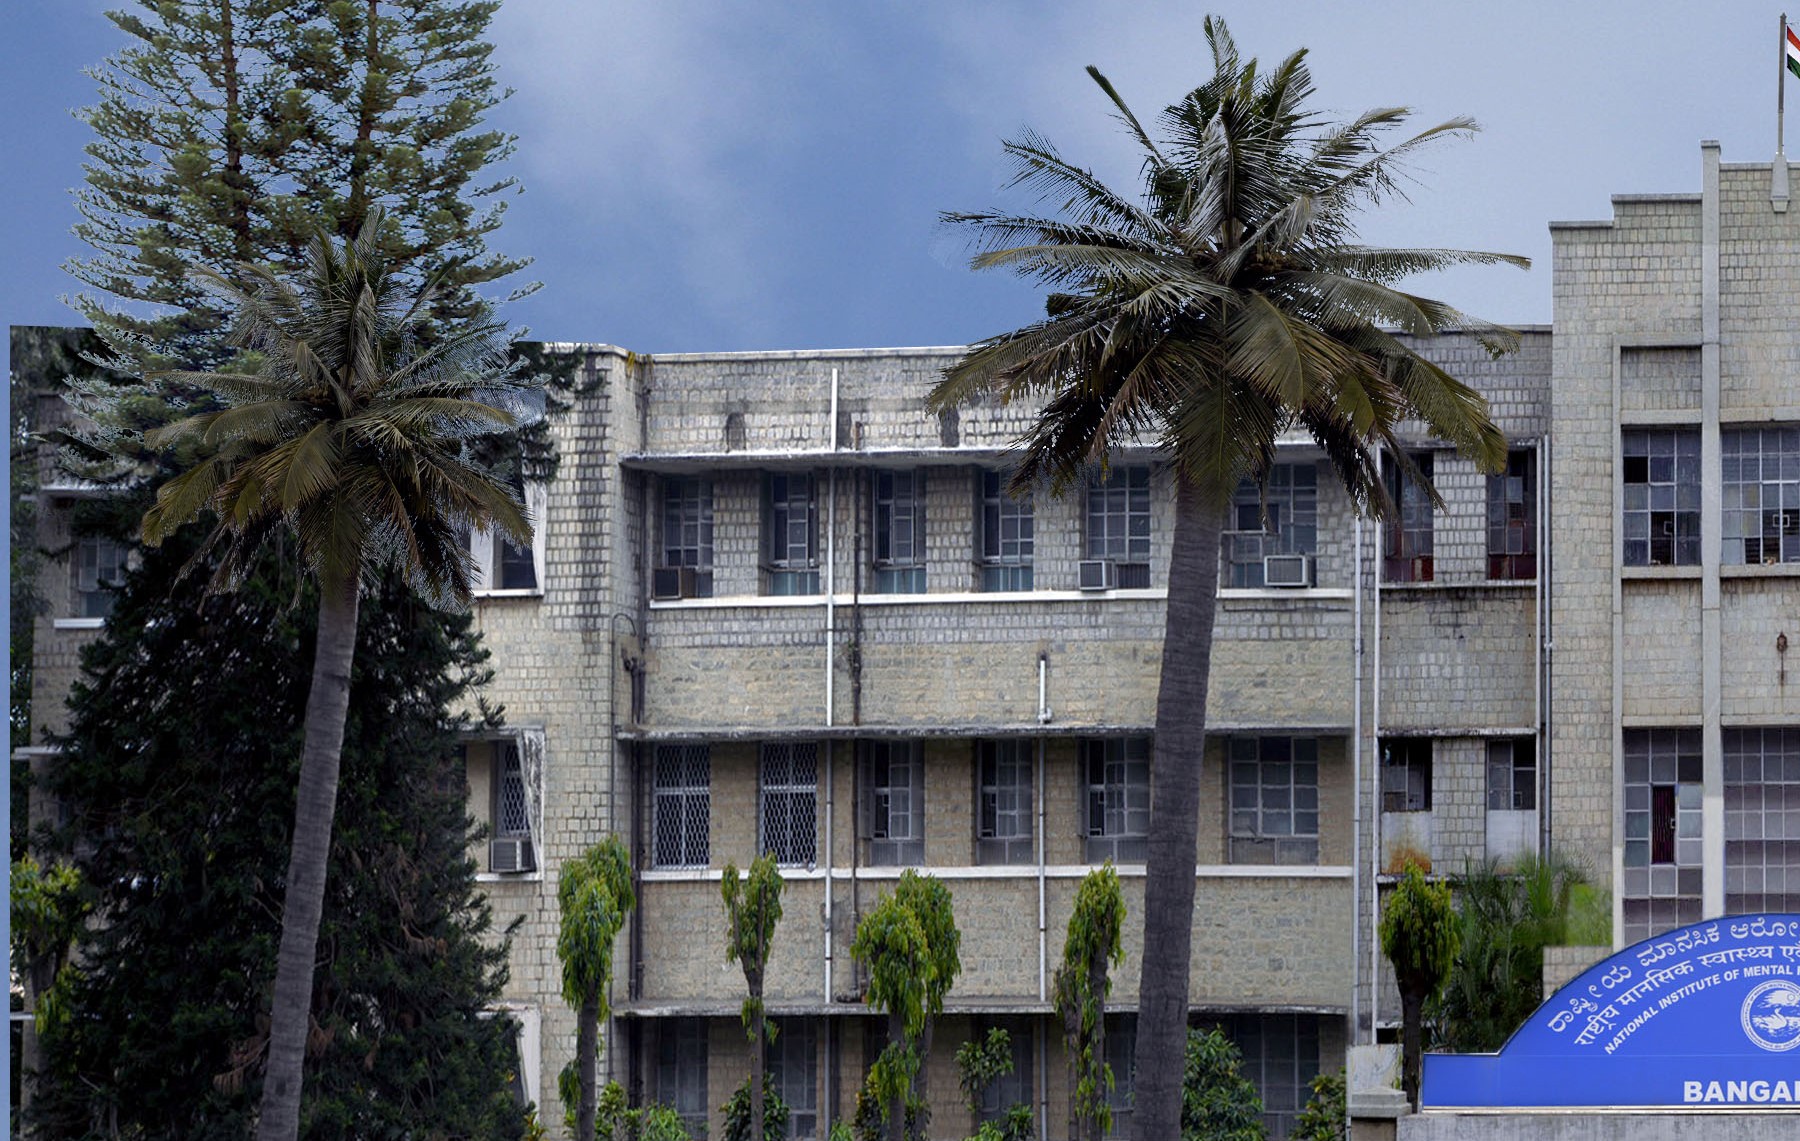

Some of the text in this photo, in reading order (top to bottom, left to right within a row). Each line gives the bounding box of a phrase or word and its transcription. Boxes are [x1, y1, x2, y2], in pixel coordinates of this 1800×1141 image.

[1636, 922, 1720, 967] ಮಾನಸಿಕ
[1615, 960, 1694, 1005] मानसिक
[1697, 945, 1774, 968] स्वास्थ्य
[1604, 1006, 1658, 1055] NATIONAL
[1658, 973, 1721, 1010] INSTITUTE
[1723, 969, 1740, 982] OF
[1743, 964, 1793, 978] MENTAL
